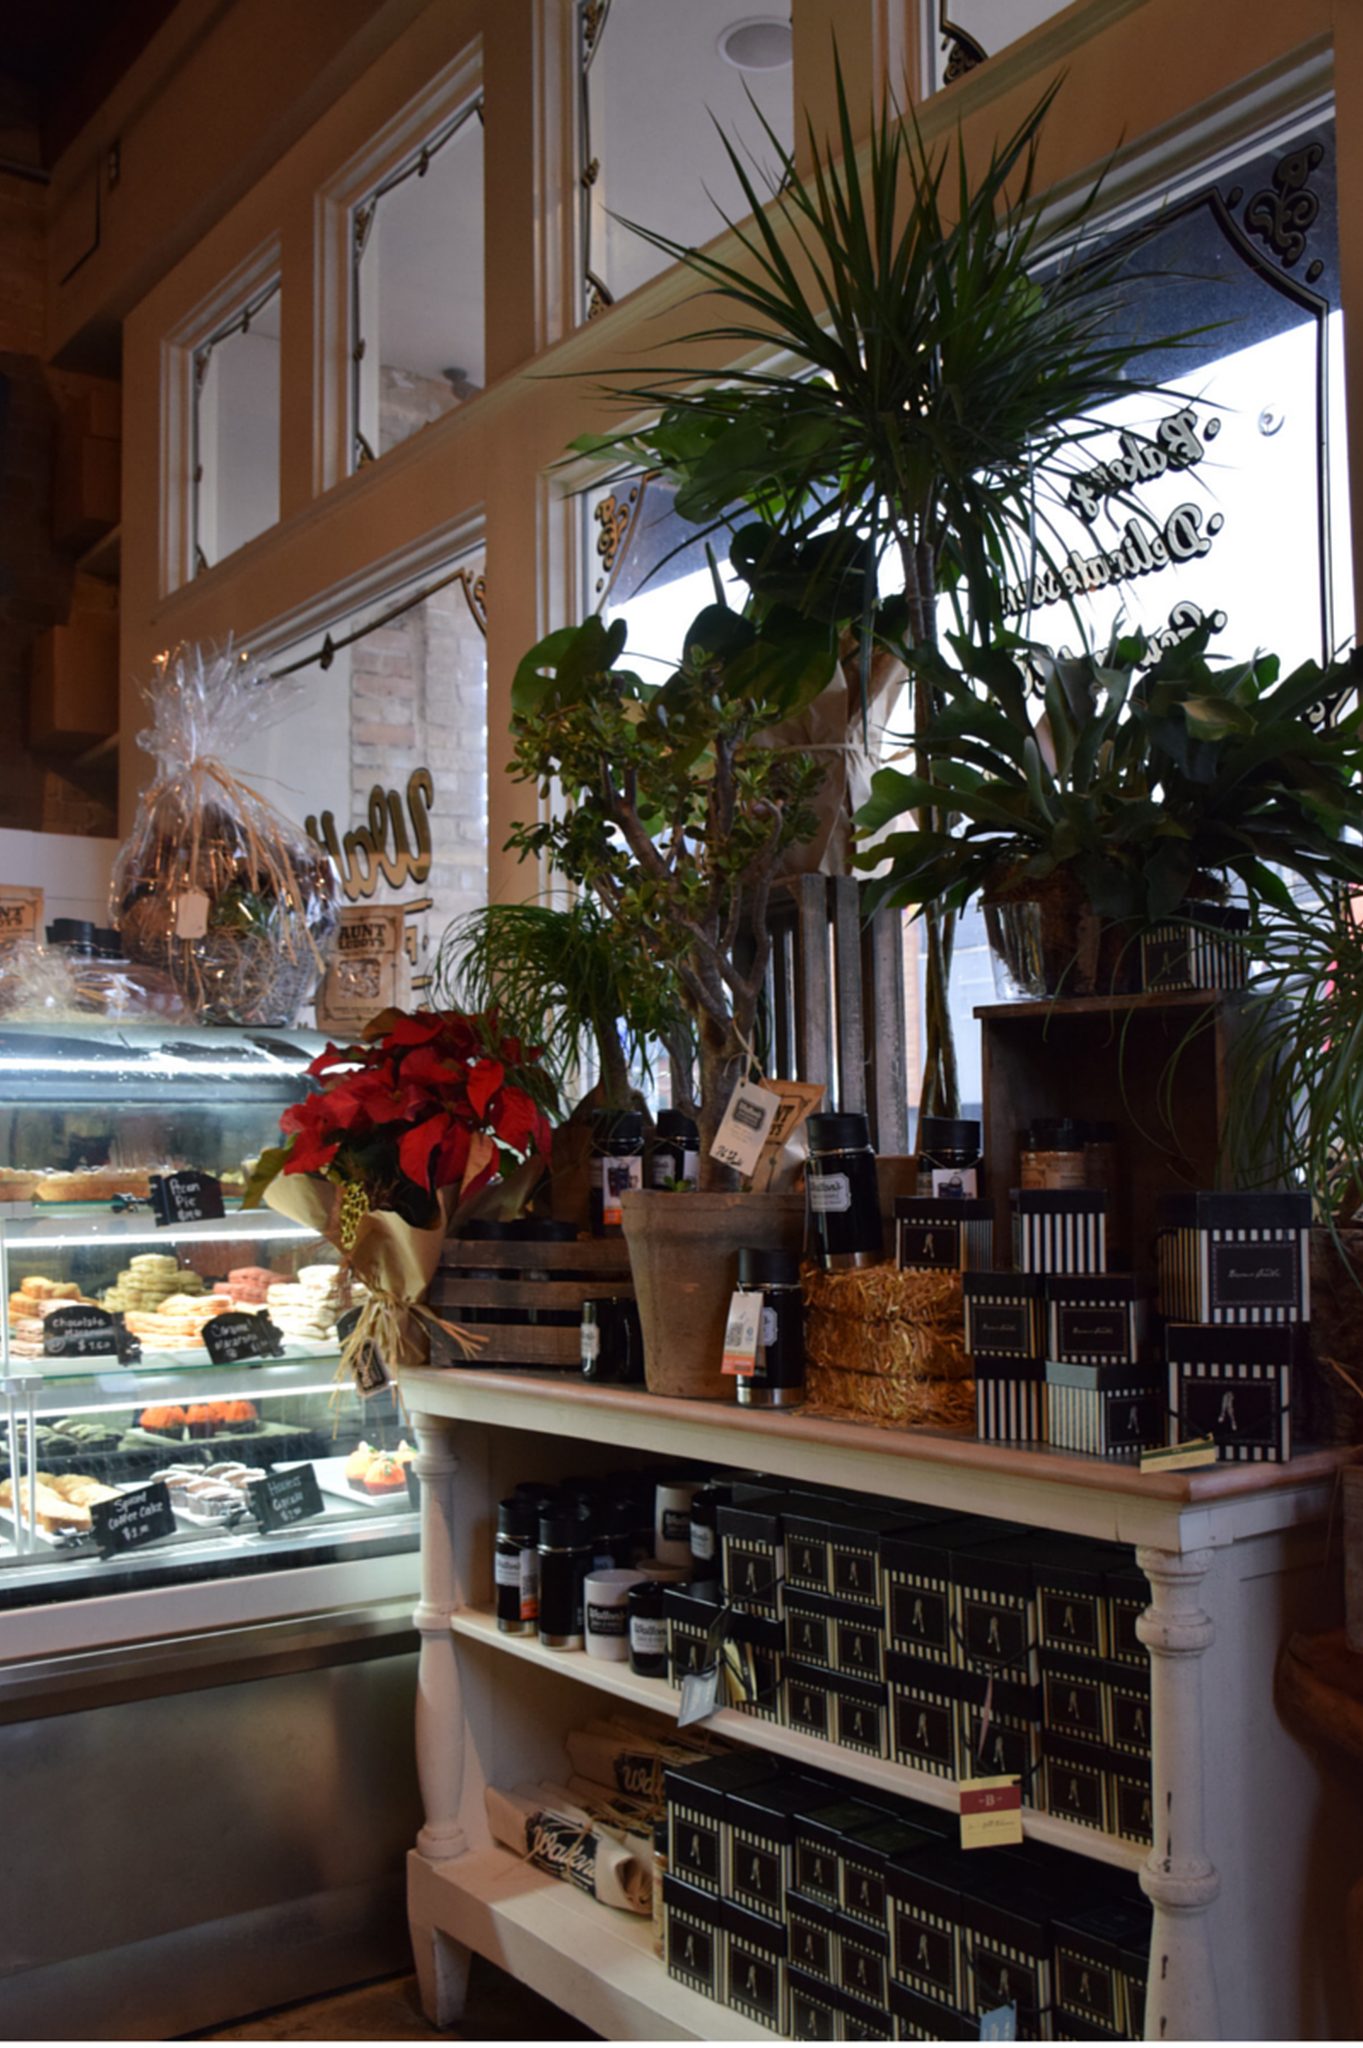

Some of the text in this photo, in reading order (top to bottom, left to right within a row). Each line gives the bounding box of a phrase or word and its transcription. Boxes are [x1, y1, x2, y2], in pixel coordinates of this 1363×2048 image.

[339, 924, 387, 940] AUNT
[108, 1501, 163, 1531] Coffee Cake
